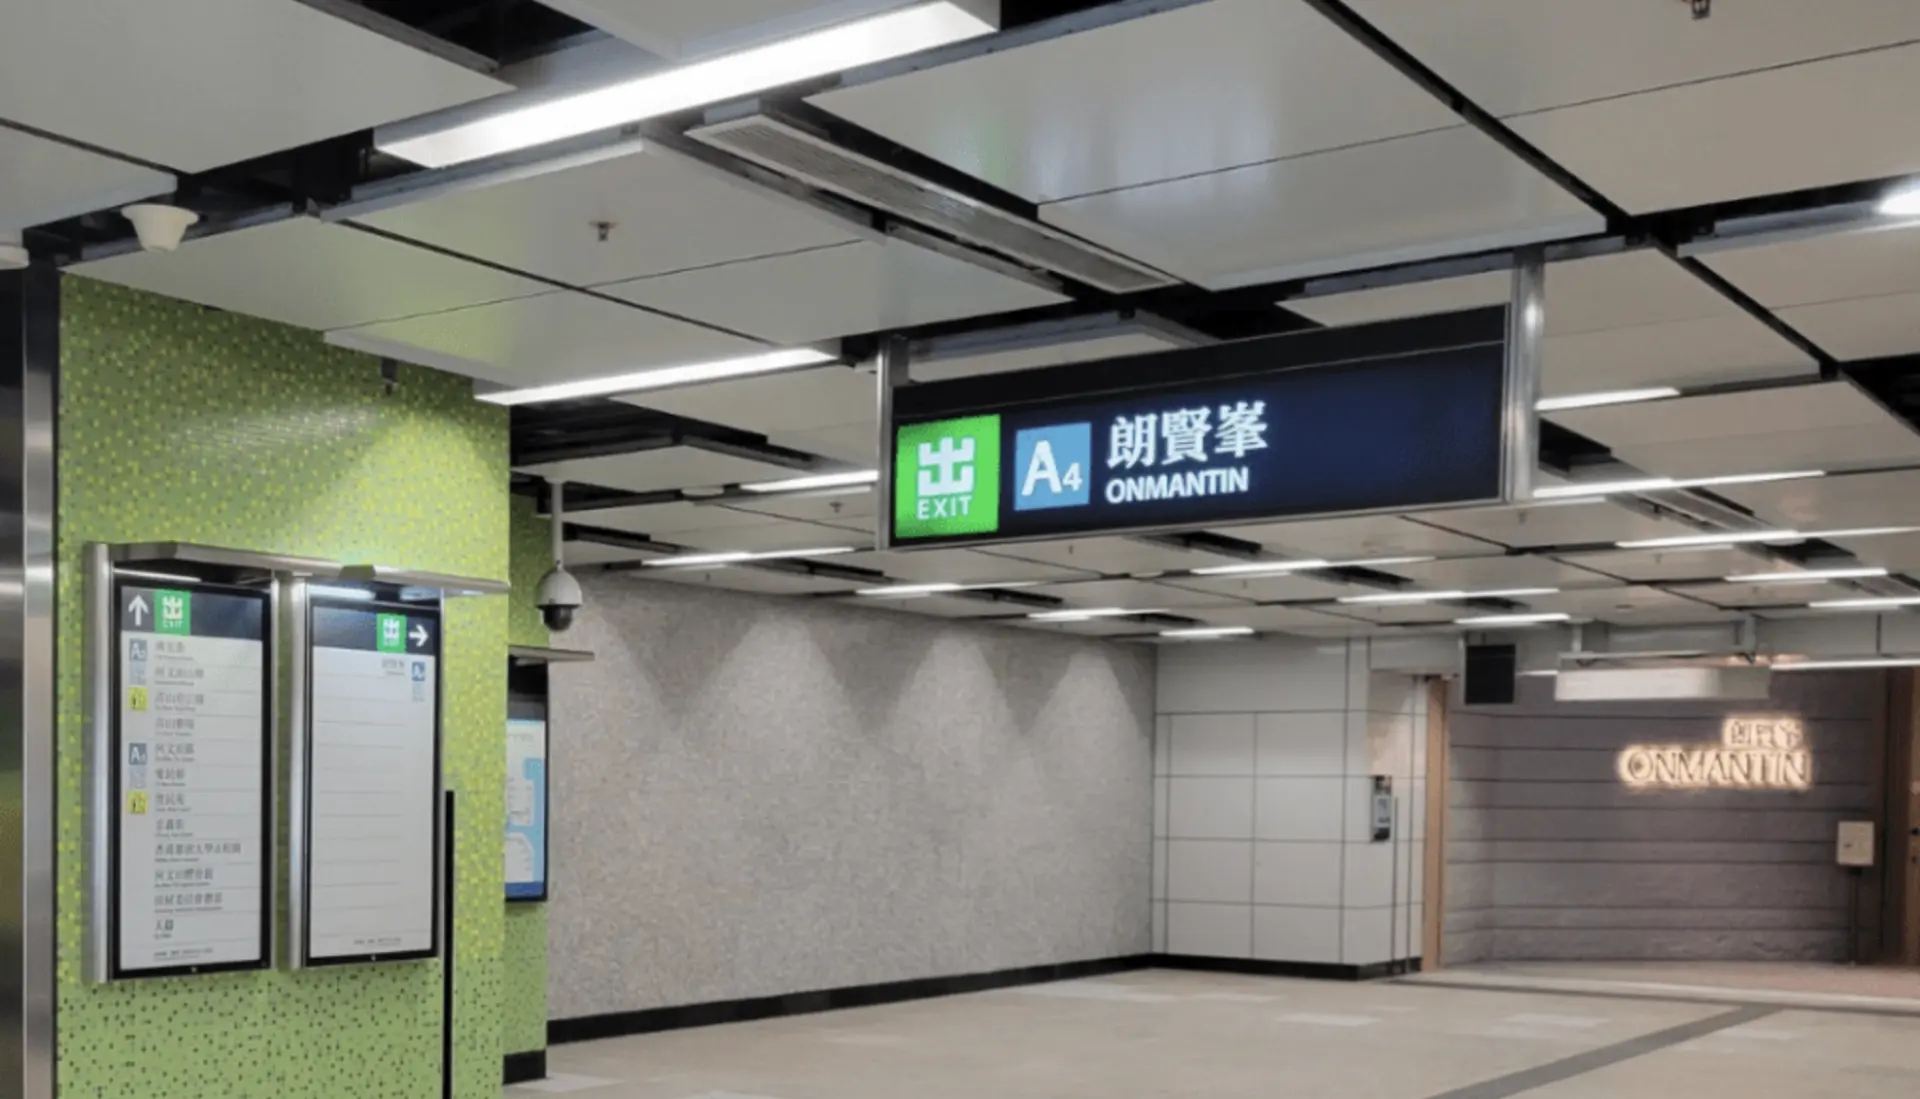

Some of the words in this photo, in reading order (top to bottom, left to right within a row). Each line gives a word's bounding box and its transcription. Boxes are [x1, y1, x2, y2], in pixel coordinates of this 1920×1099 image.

[1105, 400, 1269, 470] 朗賢峯
[917, 436, 975, 496] 出
[1021, 440, 1083, 496] A4
[1105, 466, 1249, 504] ONMANTIN
[916, 495, 973, 520] EXIT
[1627, 750, 1809, 783] ONMANTIN
